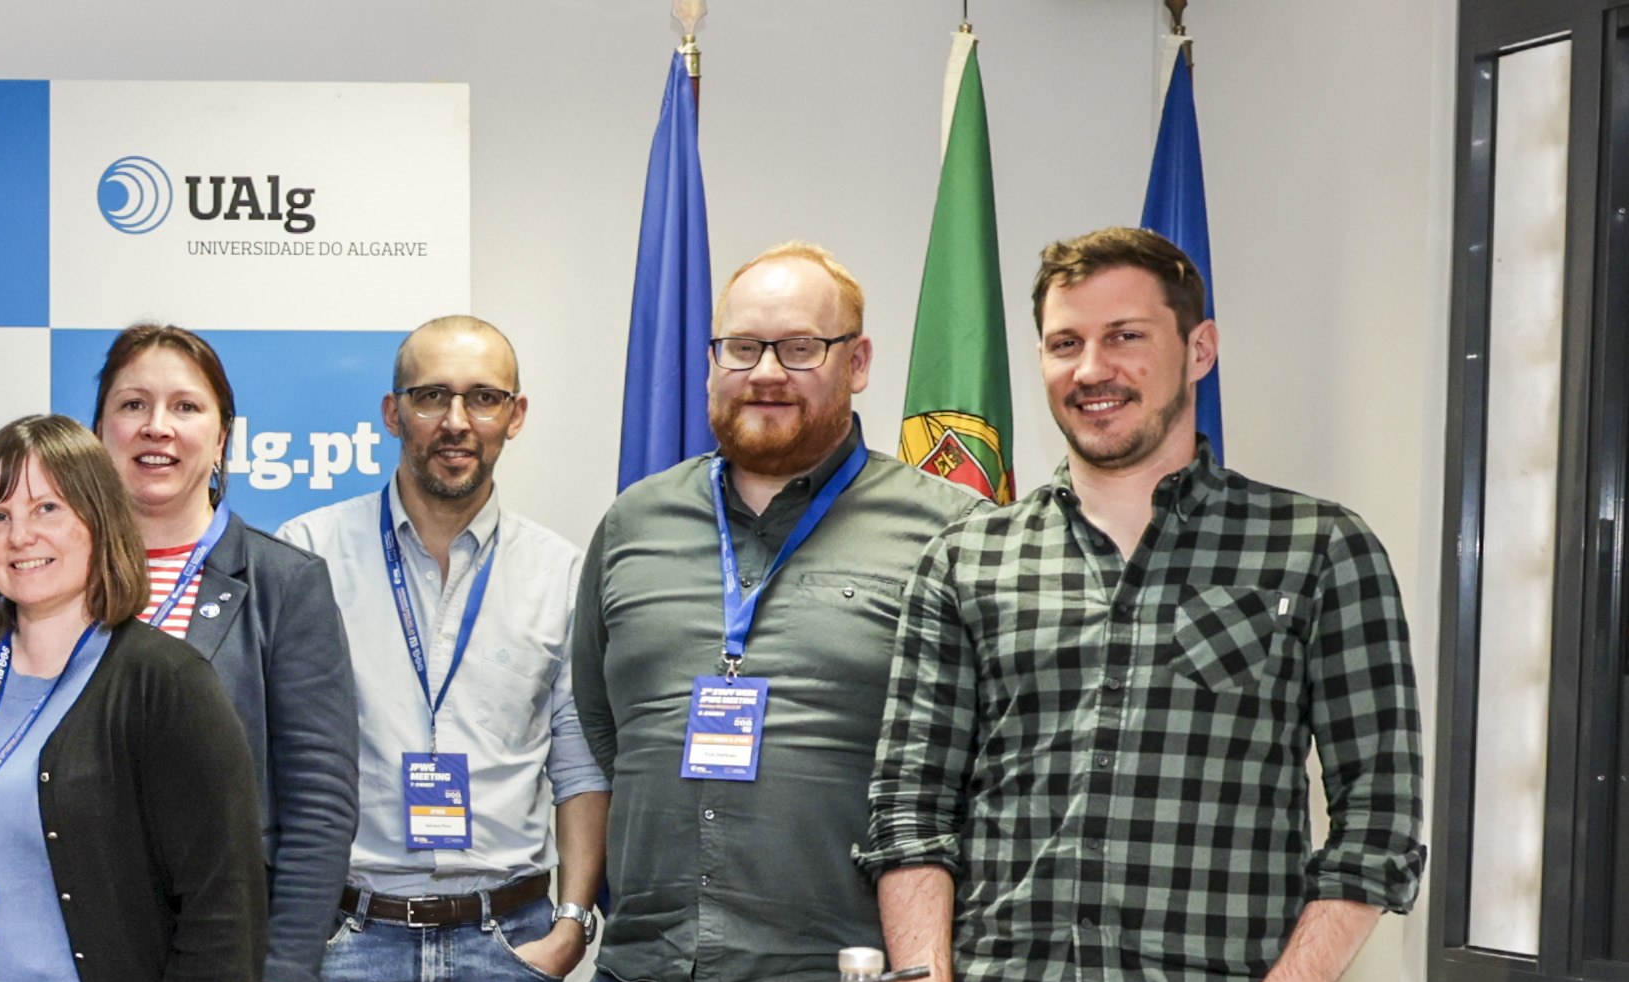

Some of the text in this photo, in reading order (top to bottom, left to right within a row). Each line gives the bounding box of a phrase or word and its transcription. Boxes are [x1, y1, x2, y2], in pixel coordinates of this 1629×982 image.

[185, 176, 316, 233] UAlg
[187, 241, 428, 256] UNIVERSIDADE DO ALGARVE
[226, 416, 381, 490] lg.pt
